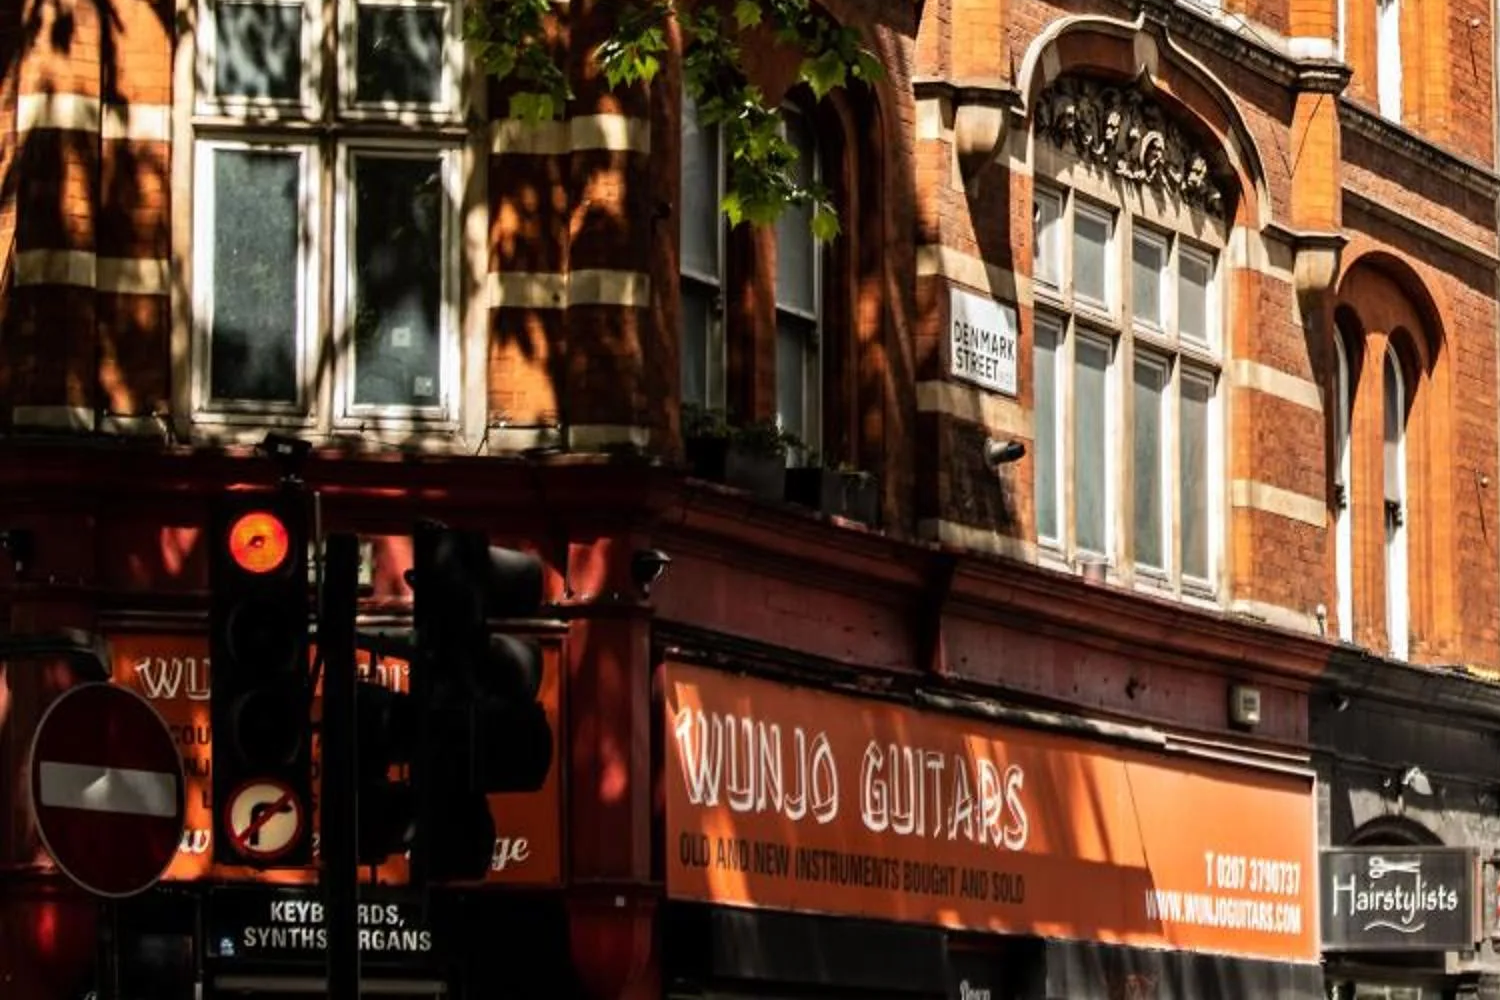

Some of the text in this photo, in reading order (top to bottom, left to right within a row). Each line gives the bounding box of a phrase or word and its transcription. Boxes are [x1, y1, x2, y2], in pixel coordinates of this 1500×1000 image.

[953, 319, 1014, 361] DENMARK
[956, 347, 999, 382] STREET
[675, 707, 1030, 851] WUNJO GUITARS
[679, 831, 1025, 905] OLD AND NEW INSTRUMENTS BOUGHT AND SOLD
[1204, 852, 1215, 887] T
[1216, 854, 1247, 890] 0207
[270, 900, 405, 926] KEYBRDS,
[1332, 872, 1459, 925] Hairstylists
[355, 928, 432, 951] RGANS
